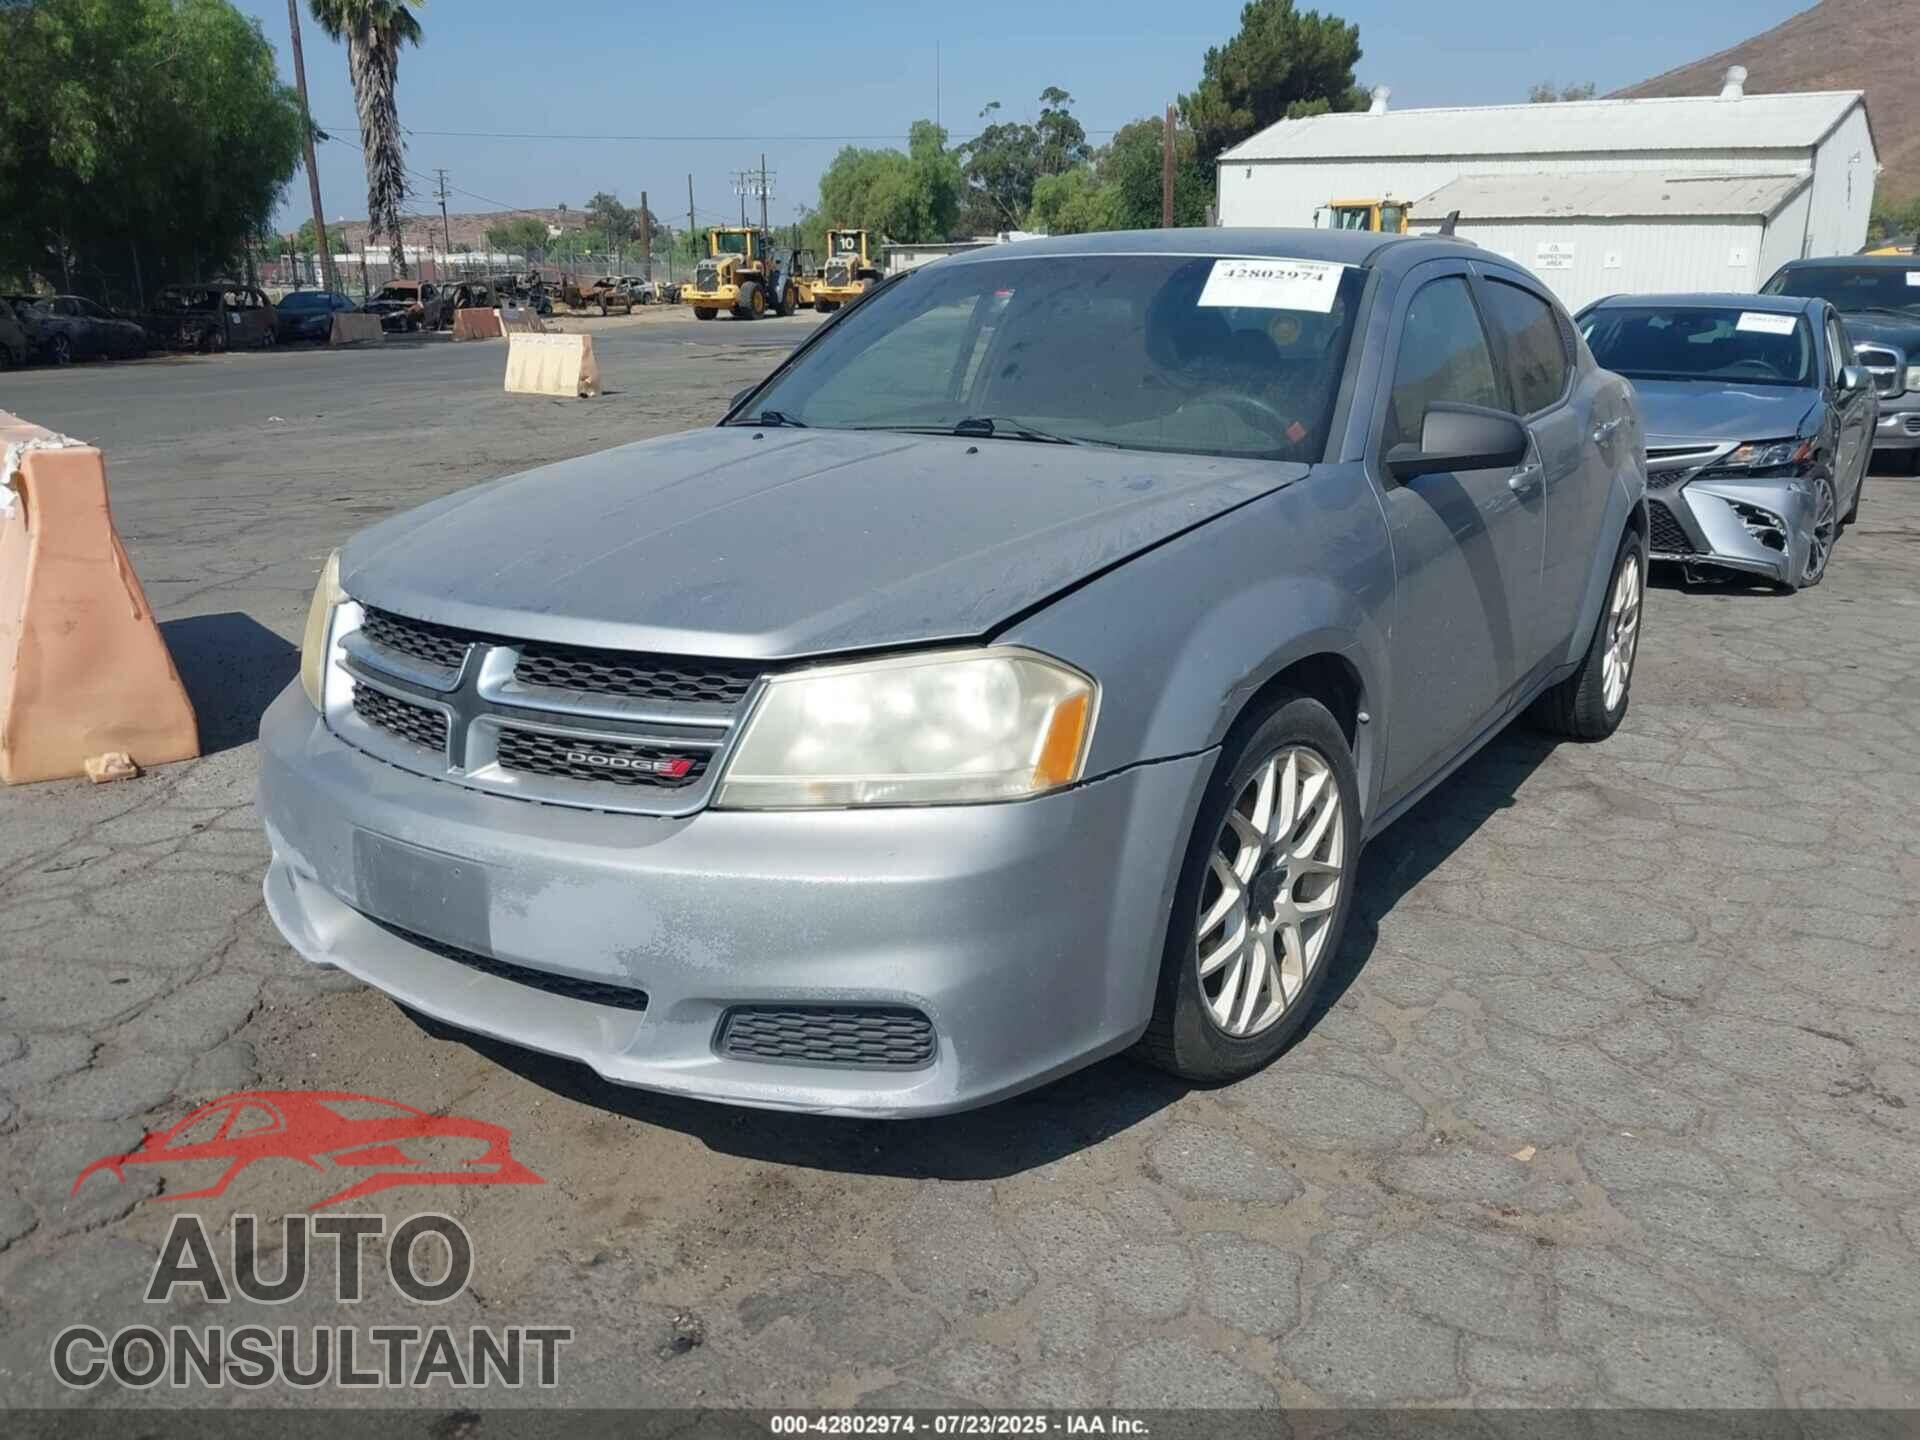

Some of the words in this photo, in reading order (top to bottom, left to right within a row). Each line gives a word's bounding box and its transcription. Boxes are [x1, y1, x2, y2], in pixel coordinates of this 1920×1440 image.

[840, 237, 855, 250] 10
[1223, 268, 1325, 281] 42802974
[566, 751, 674, 773] DODGE
